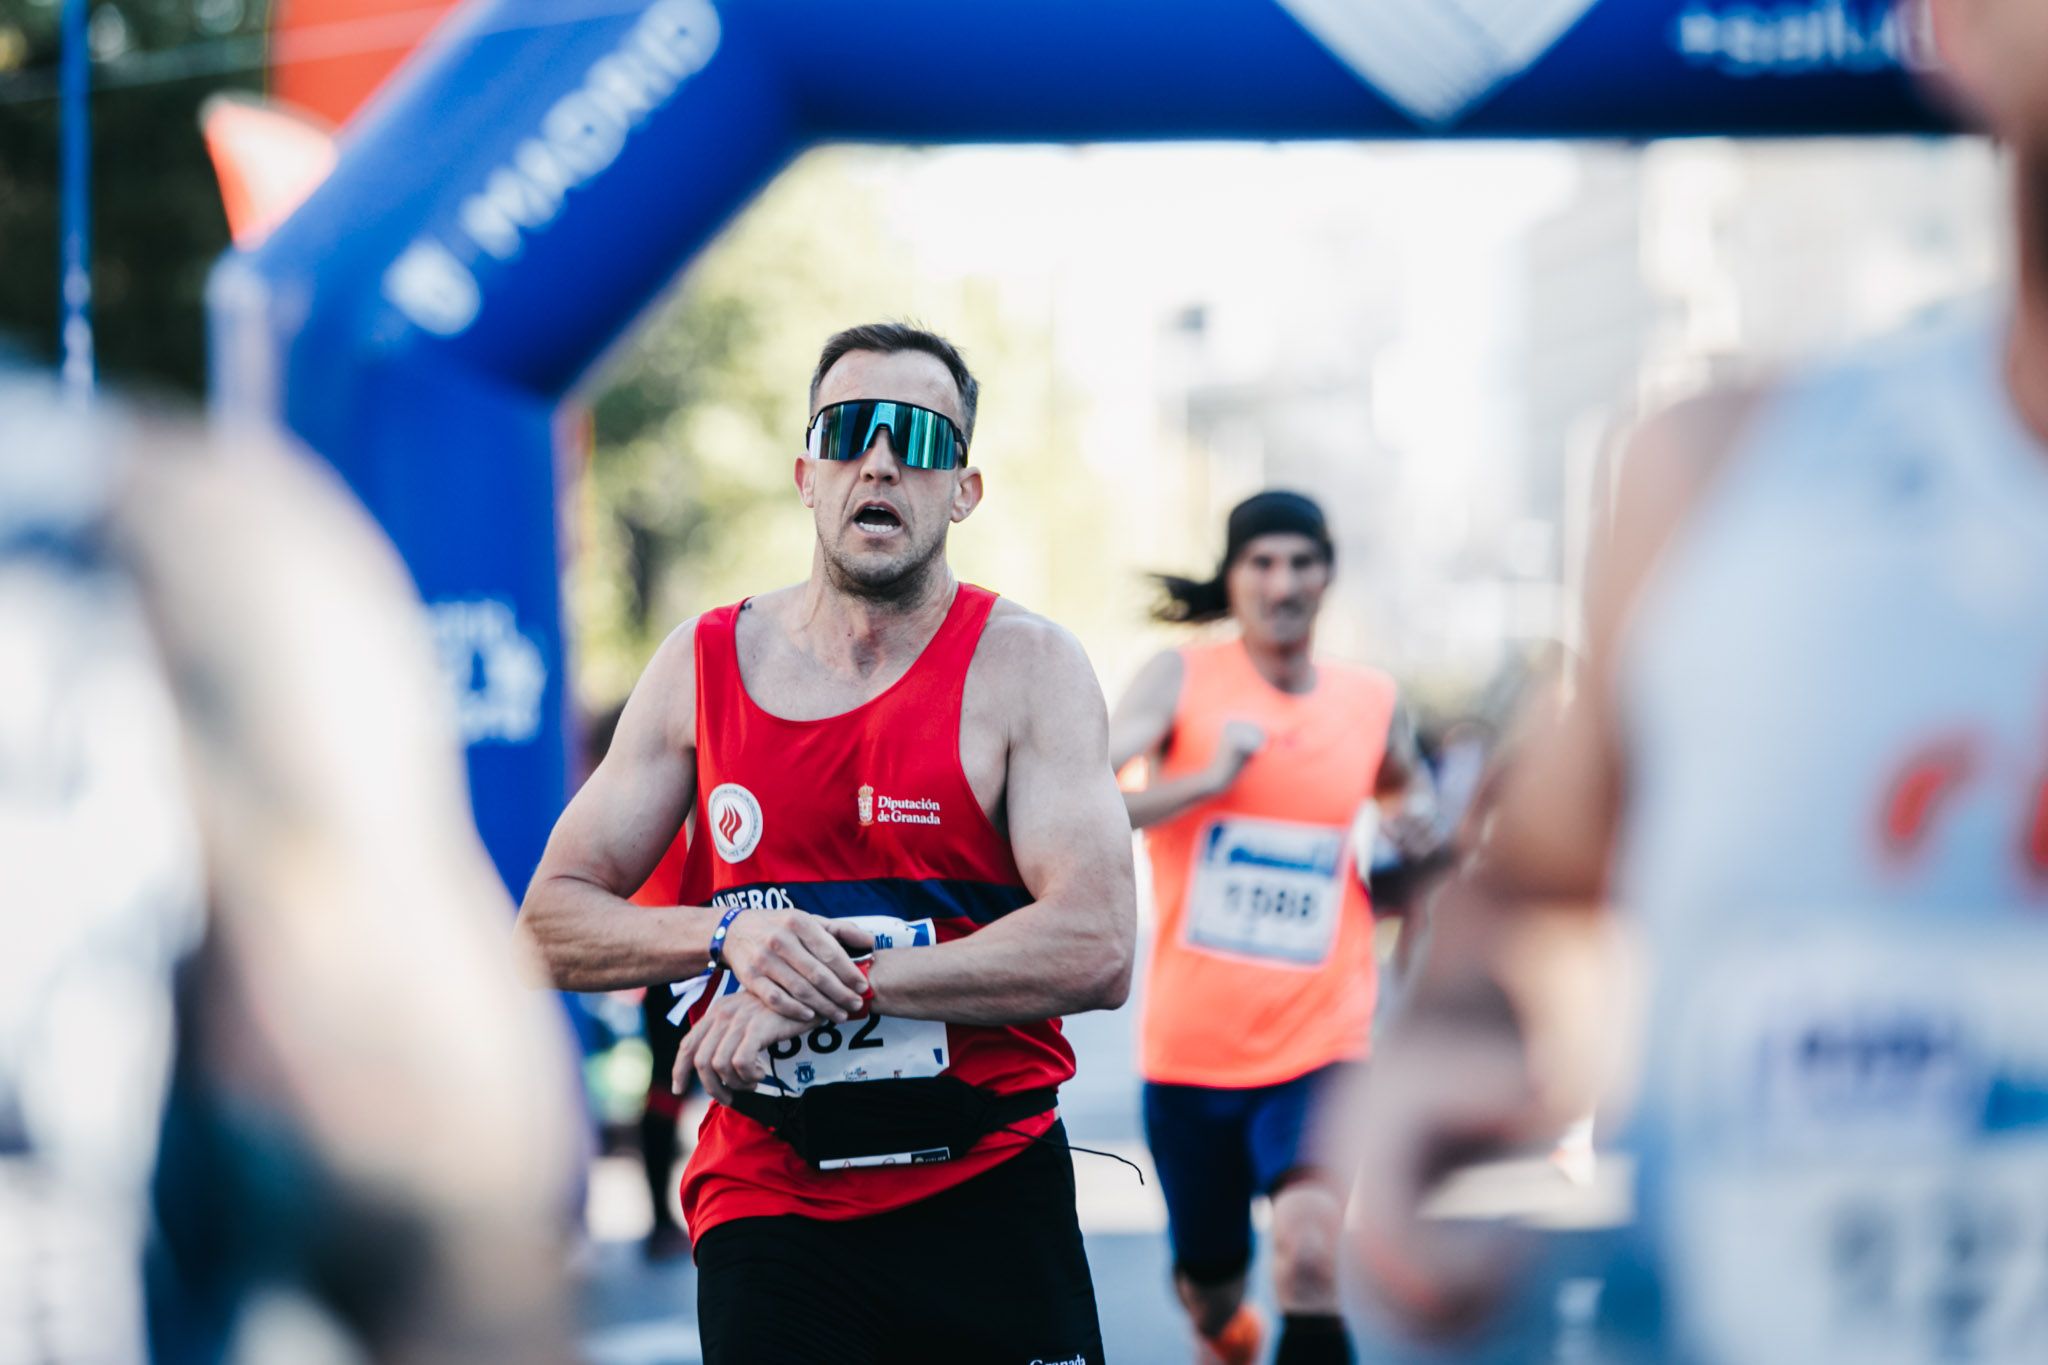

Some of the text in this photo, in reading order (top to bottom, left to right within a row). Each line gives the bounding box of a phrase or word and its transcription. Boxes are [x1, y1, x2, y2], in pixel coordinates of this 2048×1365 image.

[878, 796, 940, 811] Diputación
[877, 810, 941, 825] de Granada
